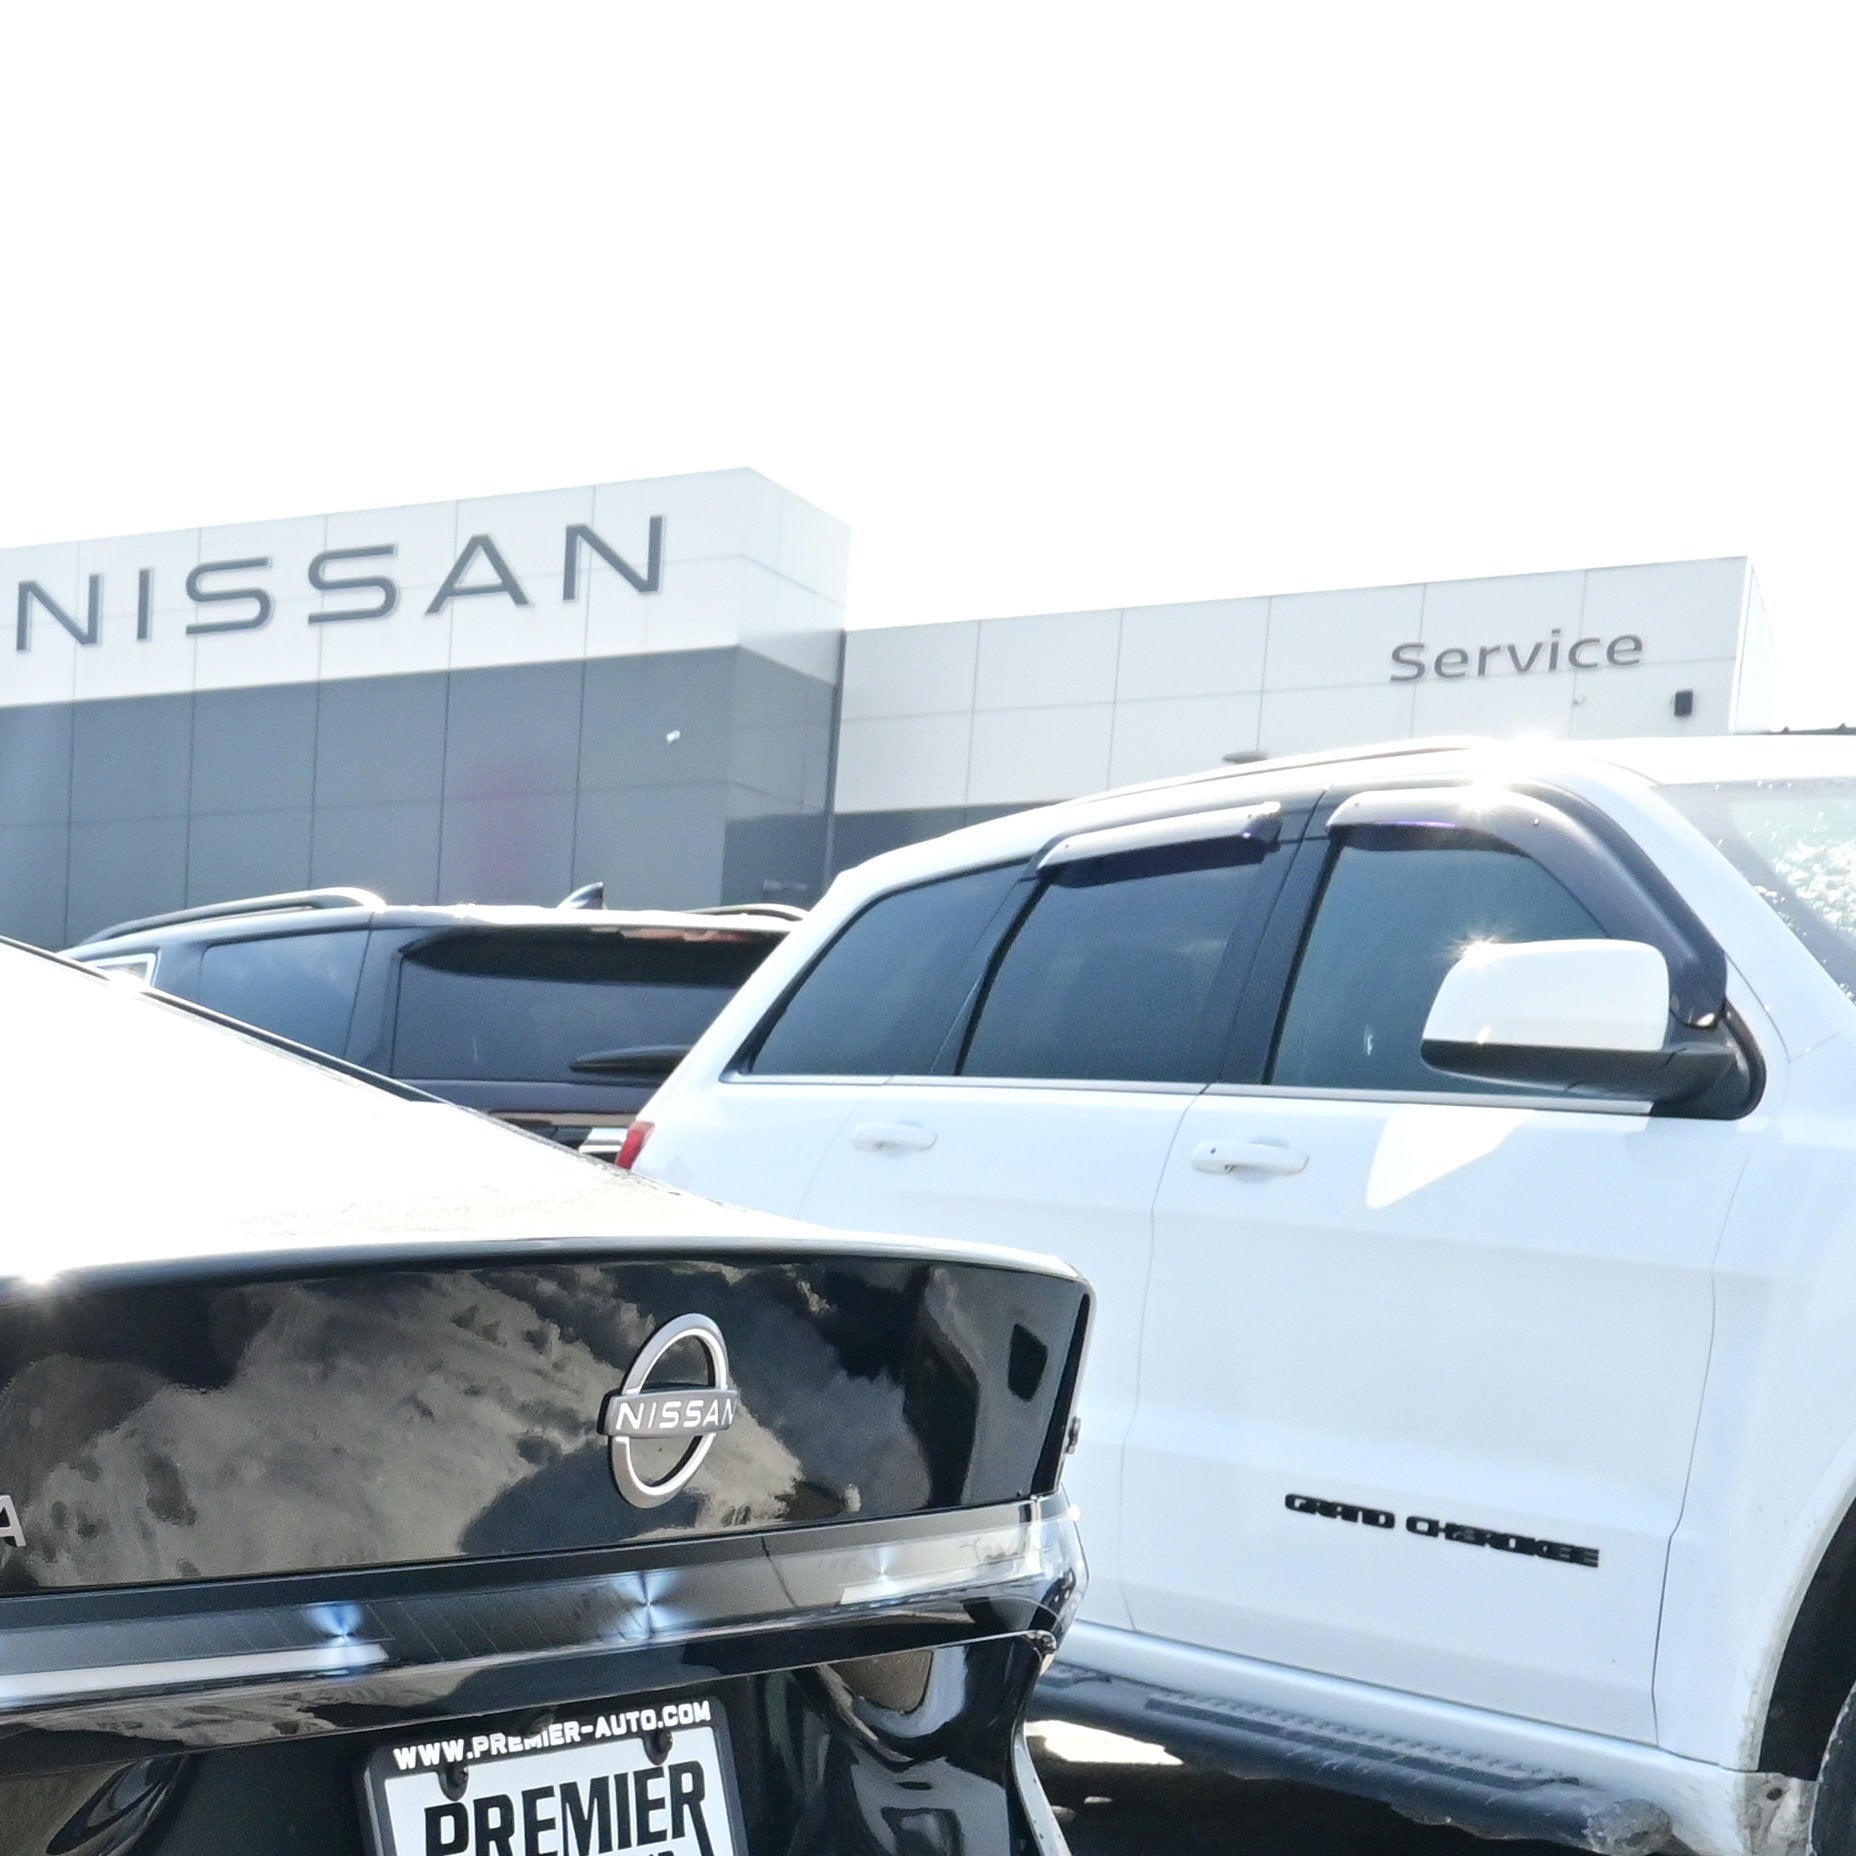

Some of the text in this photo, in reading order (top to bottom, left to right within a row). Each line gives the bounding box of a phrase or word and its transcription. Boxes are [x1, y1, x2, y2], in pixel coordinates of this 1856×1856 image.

[15, 515, 666, 654] NISSAN
[1390, 628, 1644, 682] Service
[615, 1398, 737, 1431] NISSAN
[1285, 1493, 1599, 1568] GRAND CHEROKEE
[393, 1700, 711, 1770] WWW.PREMIER-AUTO.COM
